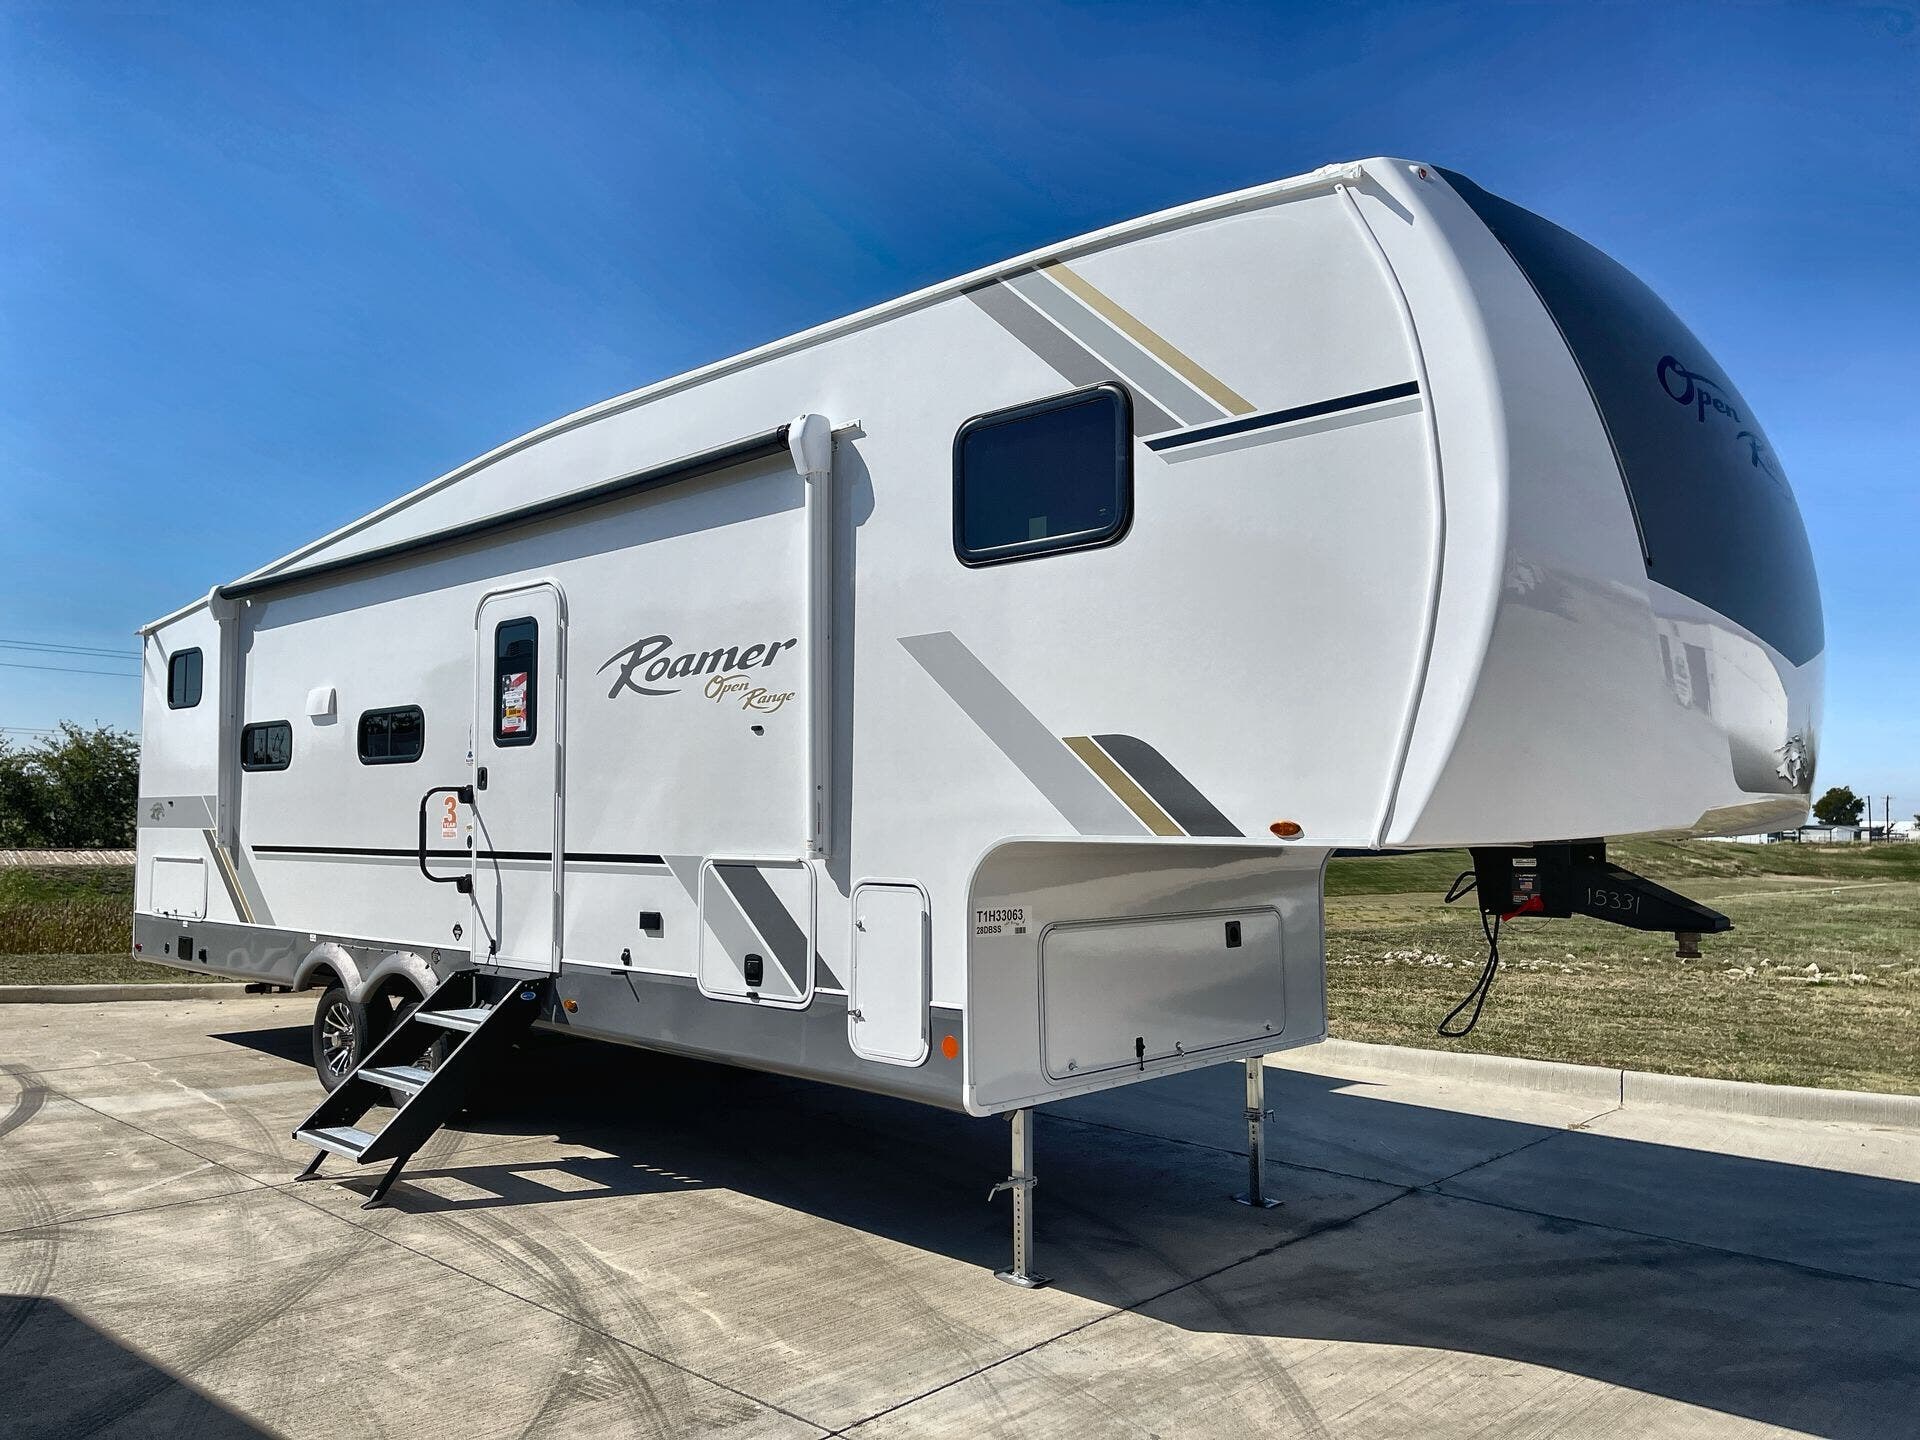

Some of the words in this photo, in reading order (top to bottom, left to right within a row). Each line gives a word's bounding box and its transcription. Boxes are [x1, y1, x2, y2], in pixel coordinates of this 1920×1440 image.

[1656, 355, 1741, 423] Open
[596, 634, 798, 699] Roamer
[704, 674, 751, 703] Open
[738, 687, 796, 713] Range
[444, 796, 457, 823] 3
[1588, 887, 1640, 914] 15331
[976, 908, 1024, 923] T1H33063
[976, 925, 1002, 935] 28DBSS
